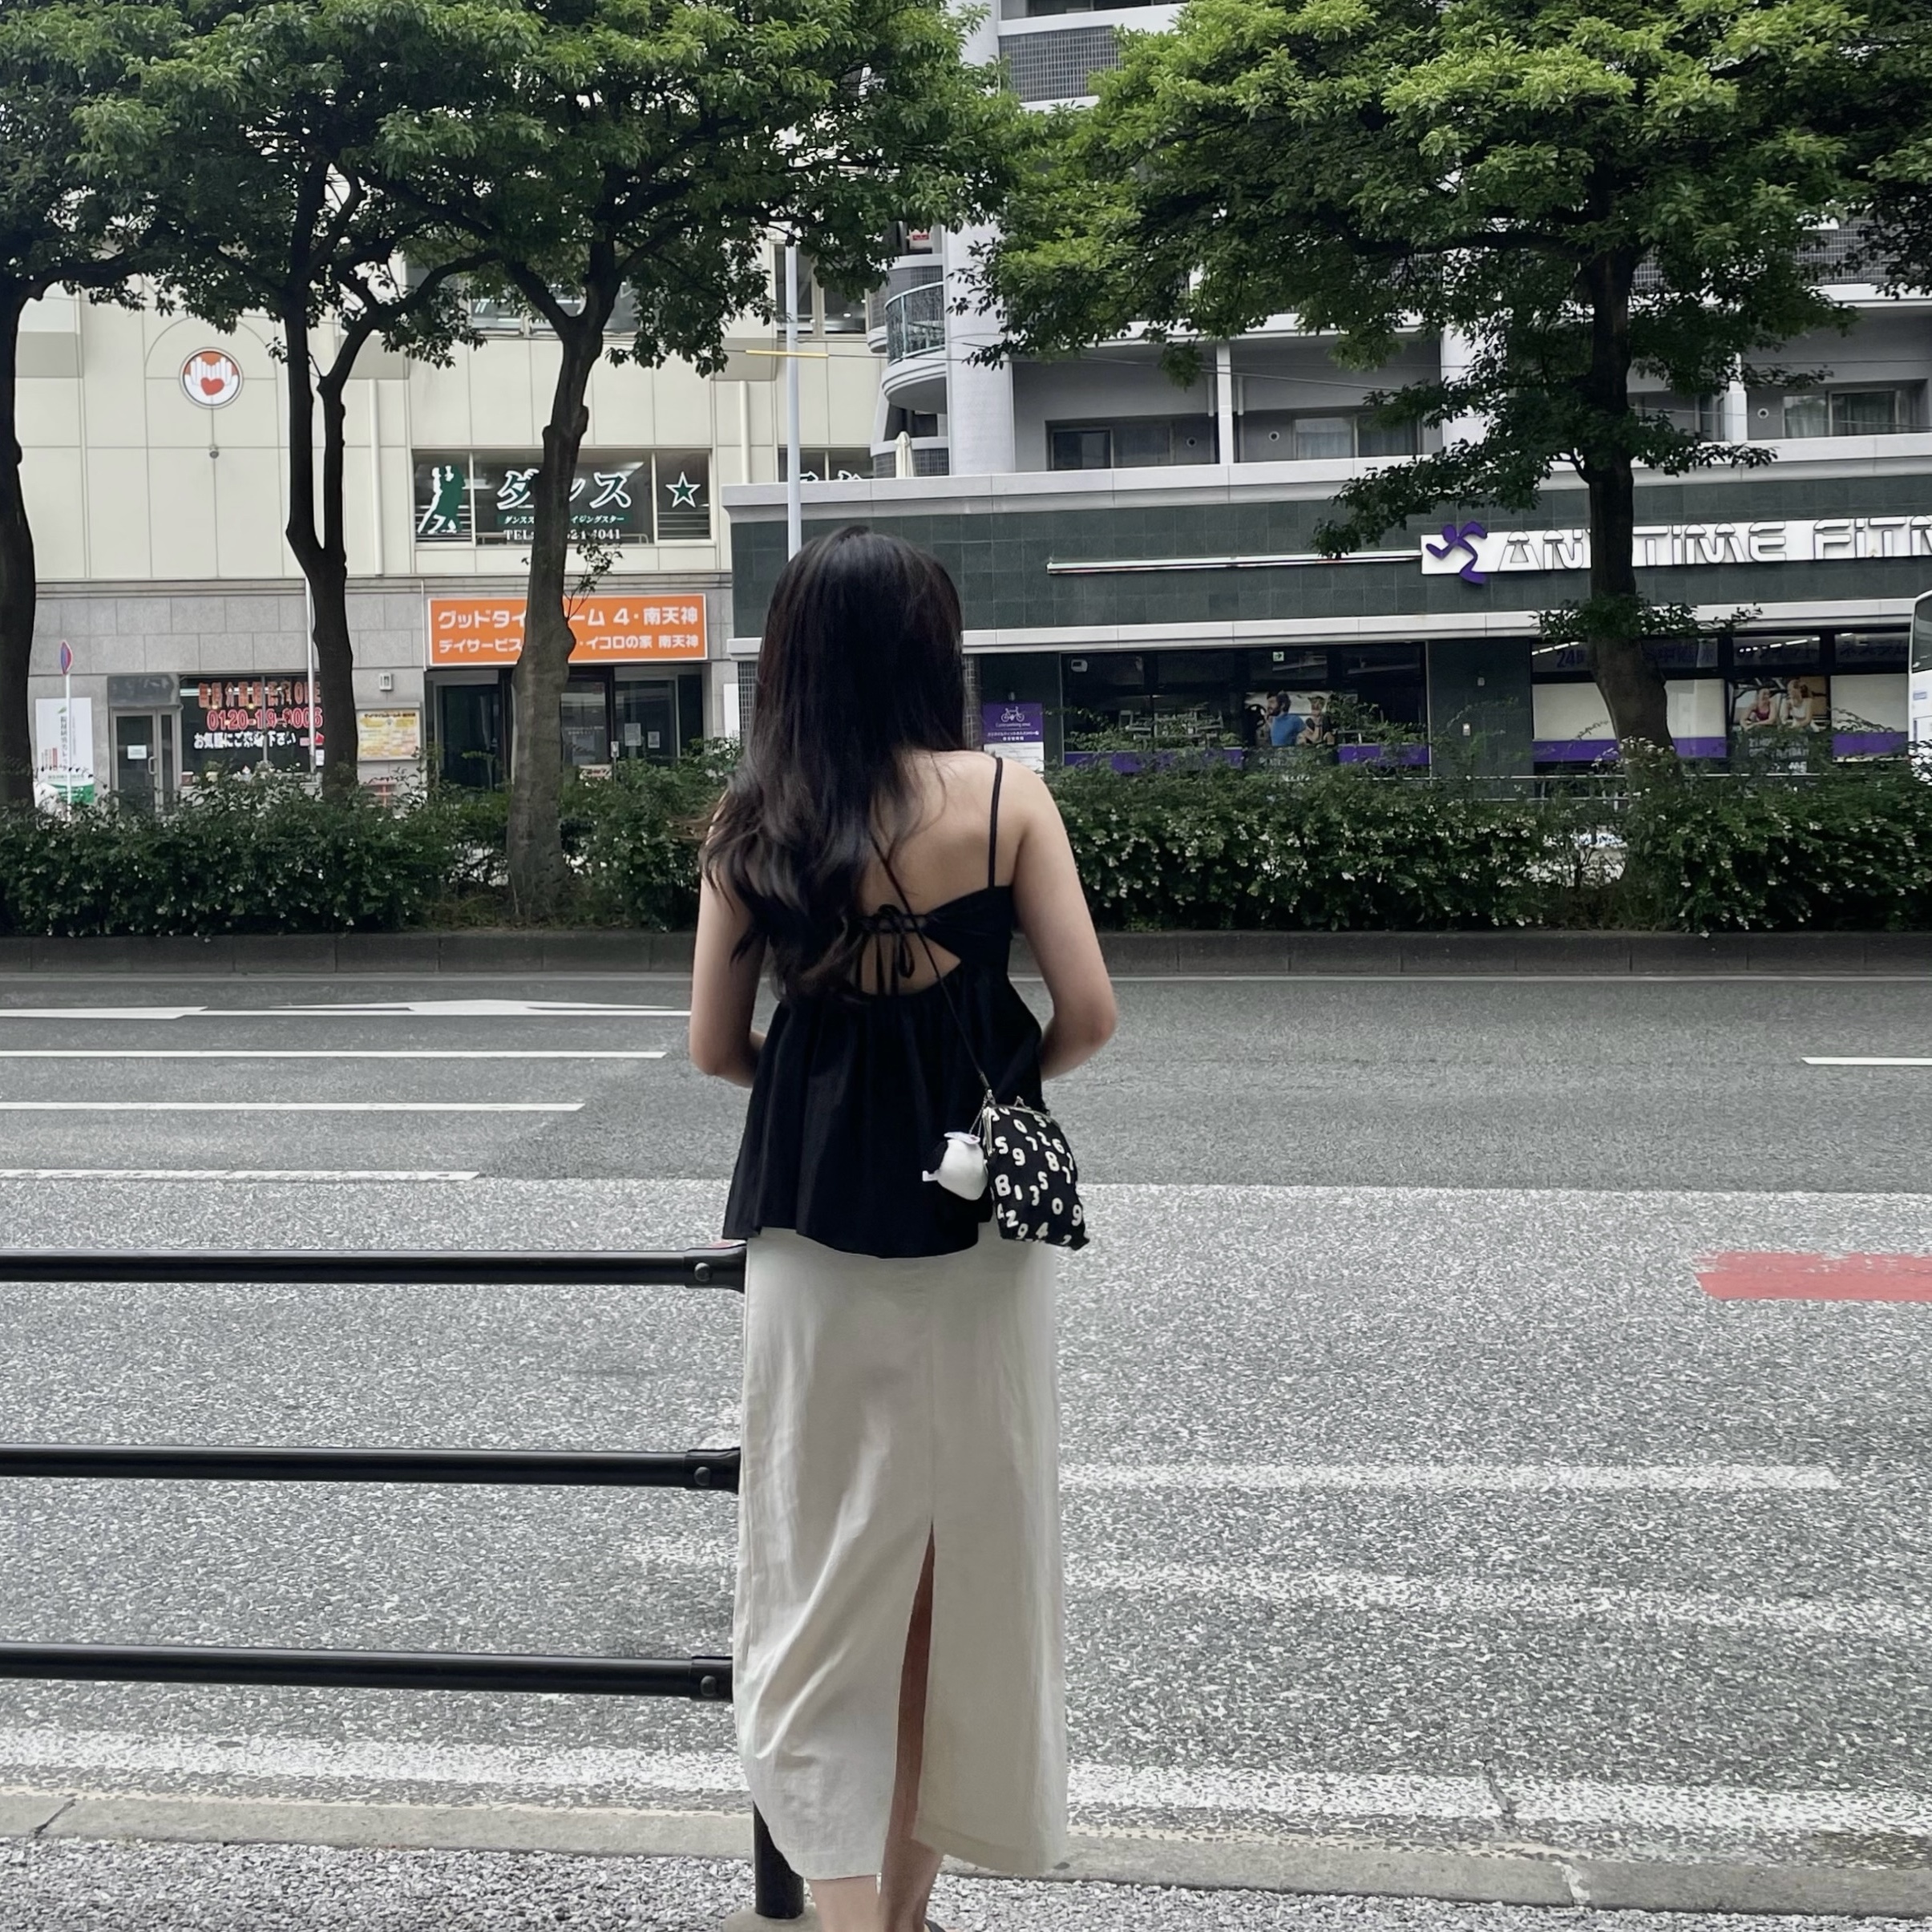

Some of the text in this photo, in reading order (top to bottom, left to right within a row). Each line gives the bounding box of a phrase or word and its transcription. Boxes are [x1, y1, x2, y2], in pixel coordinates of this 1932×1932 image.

[496, 468, 632, 510] ダス
[570, 515, 624, 524] イジングスター
[1498, 521, 1787, 571] ANTIME
[579, 635, 652, 650] イコロの家
[658, 635, 699, 649] 南天神
[1013, 1119, 1027, 1134] 0
[995, 1136, 1008, 1154] 5
[1052, 1138, 1065, 1154] 6
[1012, 1148, 1025, 1166] 9
[1045, 1151, 1059, 1171] 8
[1038, 1171, 1049, 1190] 5
[1052, 1198, 1063, 1215] 0
[1072, 1204, 1082, 1227] 9
[1006, 1210, 1019, 1227] 2
